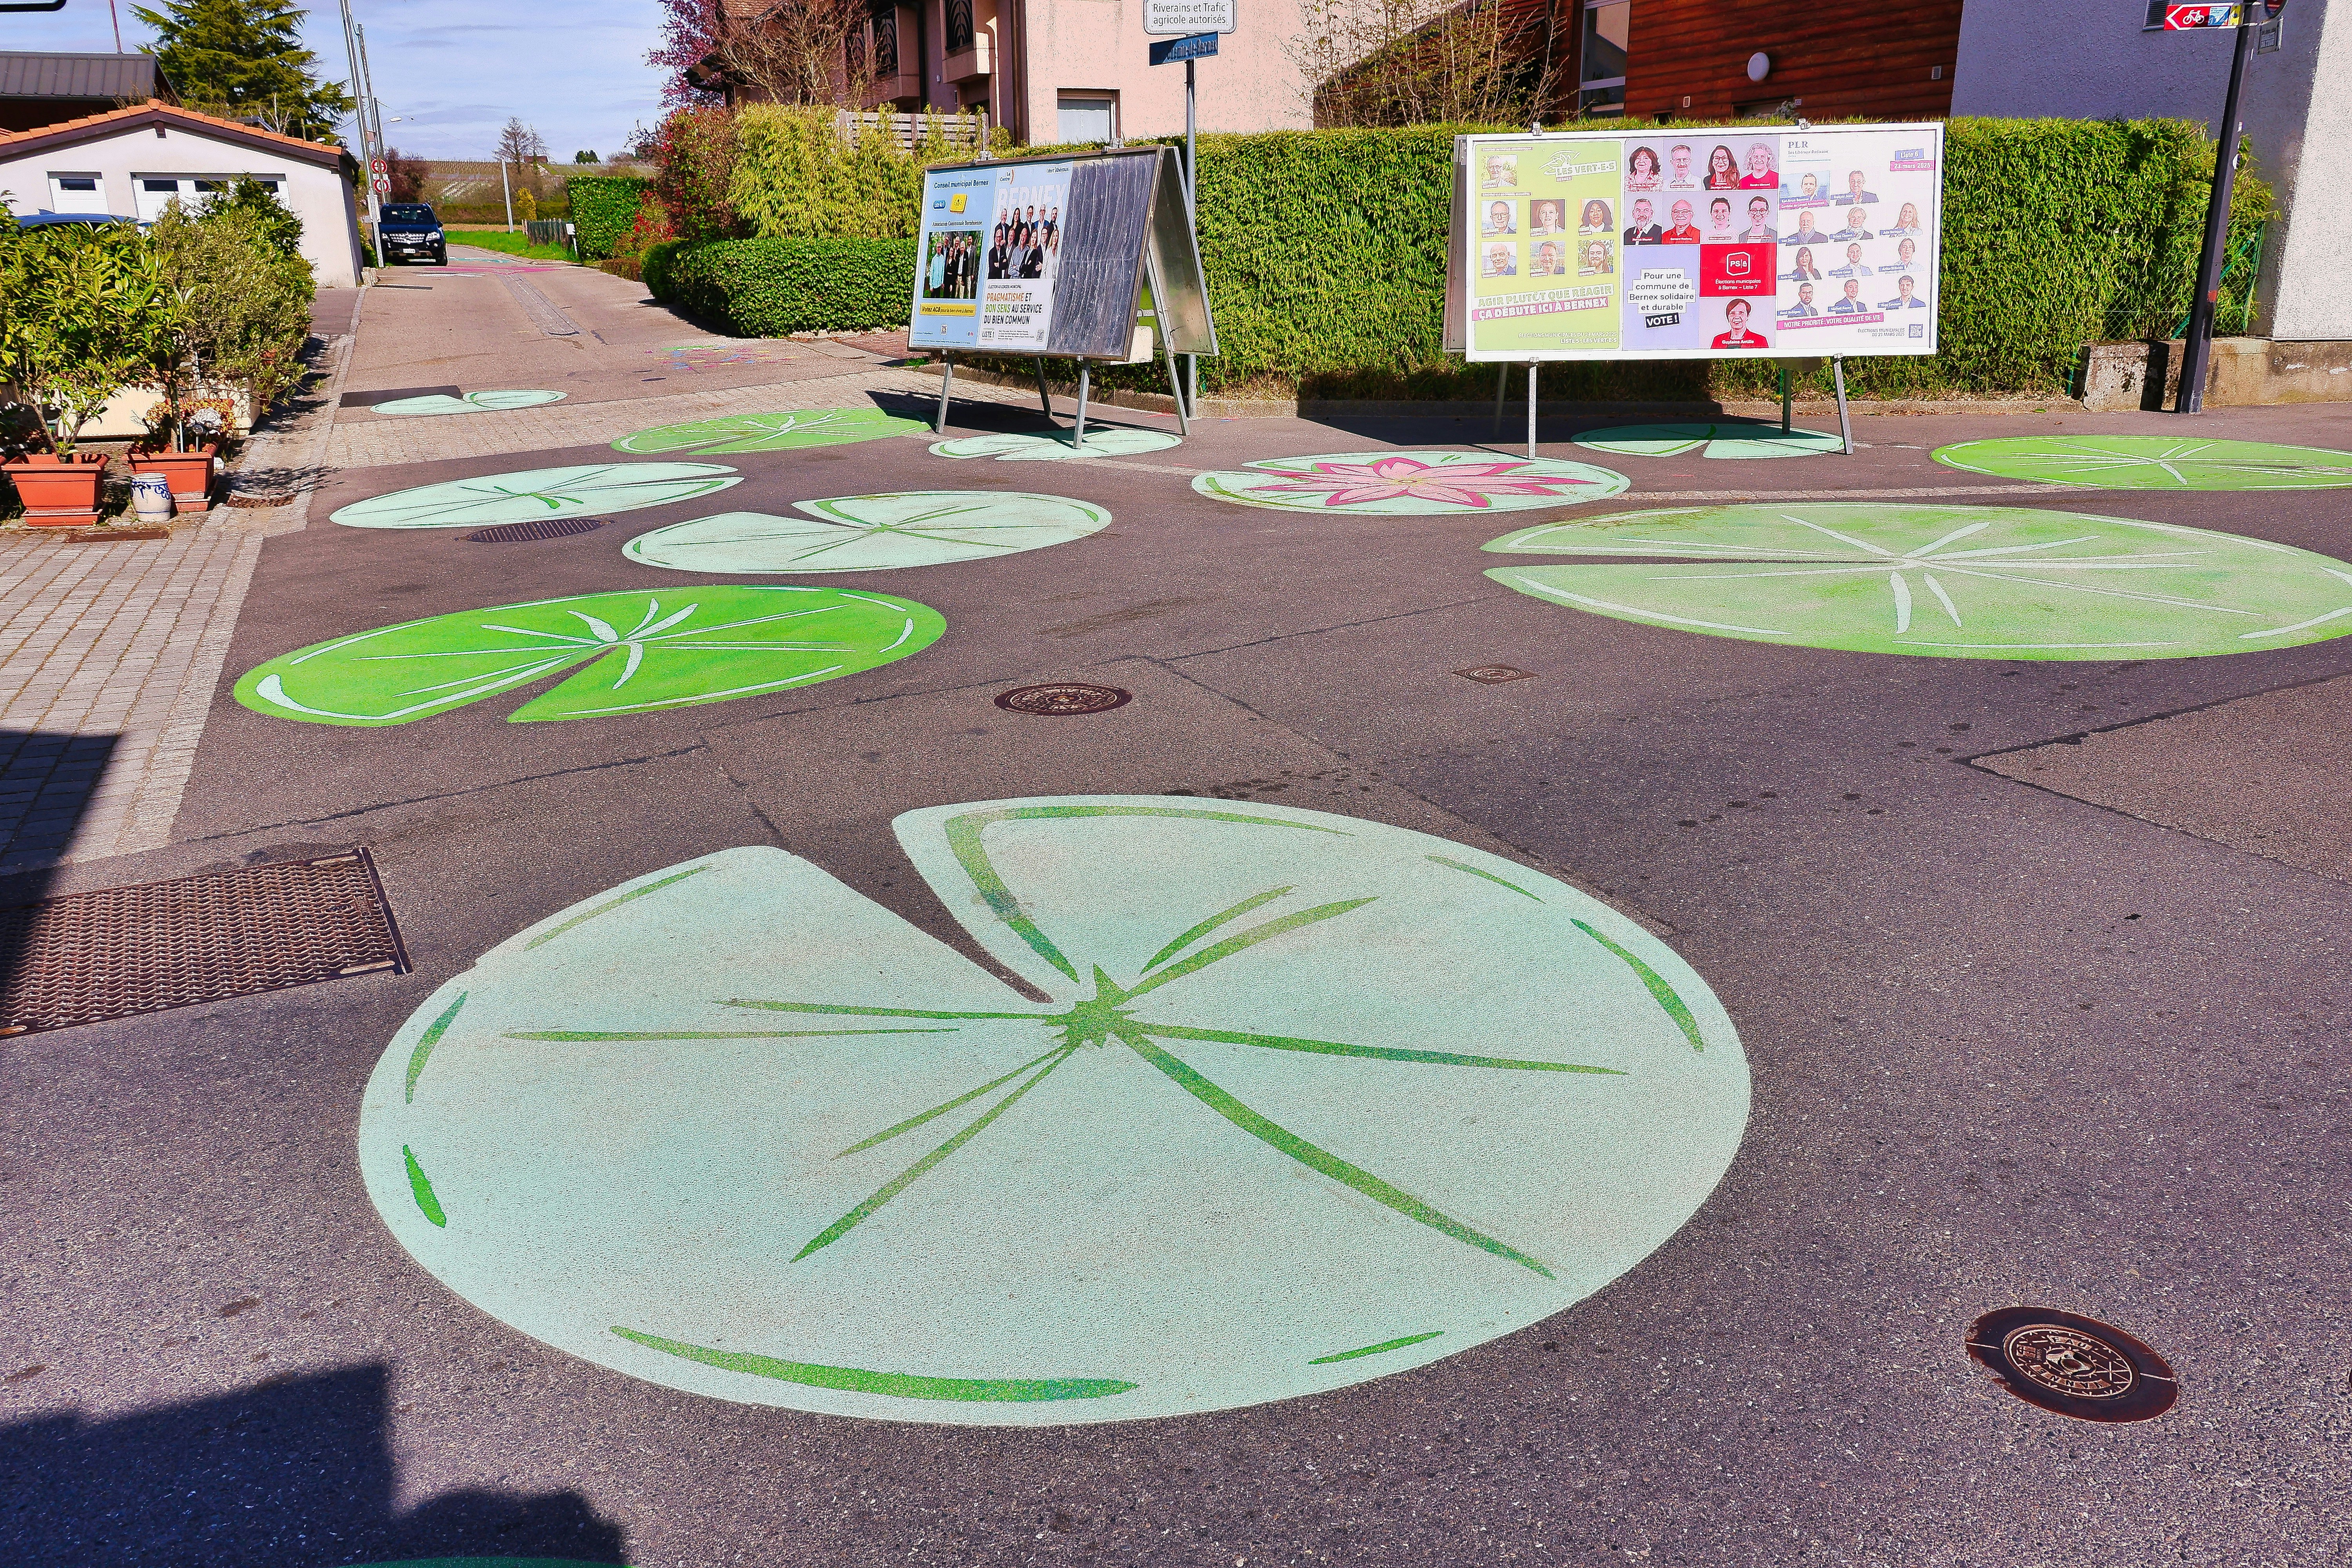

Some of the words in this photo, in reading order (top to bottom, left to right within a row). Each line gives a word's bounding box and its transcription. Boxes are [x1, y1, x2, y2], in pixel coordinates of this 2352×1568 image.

[1153, 3, 1191, 13] Riverains
[1204, 3, 1225, 12] Trafic
[1153, 15, 1186, 26] agricole
[1189, 14, 1225, 24] autorisés
[951, 180, 972, 188] municipal
[996, 183, 1067, 217] BERNEX
[987, 293, 1024, 301] PRAGMATISME
[1025, 293, 1032, 301] ET
[1479, 297, 1504, 307] AGIR
[1548, 290, 1570, 301] QUE
[1573, 286, 1612, 297] RÉAGIR
[985, 304, 996, 313] BON
[997, 304, 1010, 313] SENS
[1011, 304, 1019, 313] AU
[1020, 304, 1042, 313] SERVICE
[1479, 310, 1493, 321] ÇA
[1495, 305, 1537, 318] DÉBUTE
[1539, 303, 1553, 313] ICI
[1554, 301, 1564, 312] À
[1564, 298, 1608, 310] BERNEX
[984, 316, 991, 324] DU
[992, 316, 1004, 324] BIEN
[1005, 316, 1030, 325] COMMUN
[1843, 315, 1864, 323] QUALITÉ
[2053, 1337, 2086, 1348] EAU
